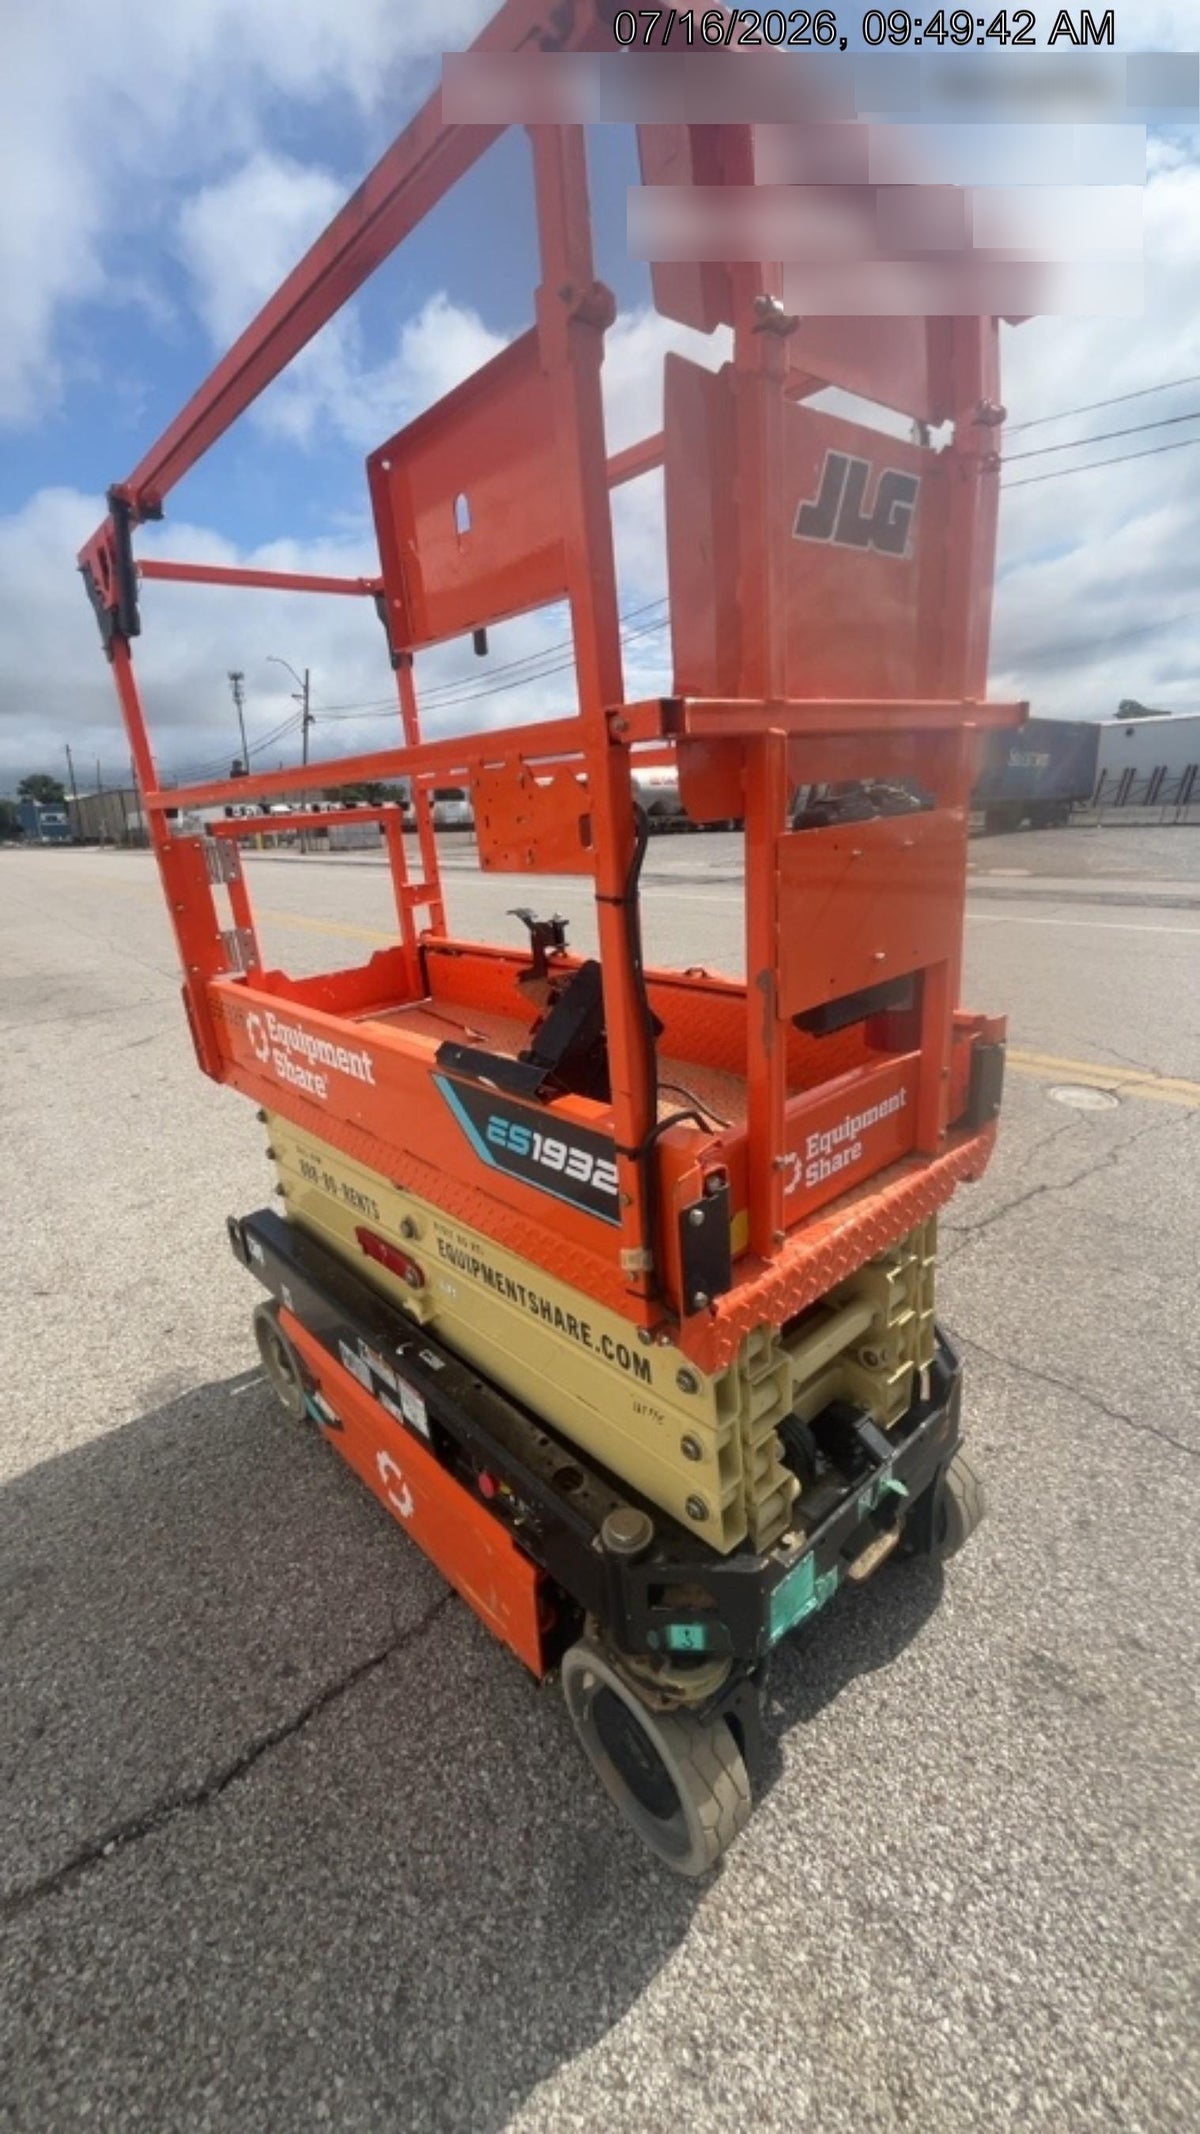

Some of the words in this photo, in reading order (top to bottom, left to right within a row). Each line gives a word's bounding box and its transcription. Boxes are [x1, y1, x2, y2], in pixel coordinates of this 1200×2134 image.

[792, 448, 921, 559] JLG
[265, 1011, 376, 1086] Equipment
[272, 1047, 328, 1099] Share
[486, 1115, 620, 1196] ES1932
[805, 1086, 907, 1160] Equipment
[805, 1142, 863, 1188] Share
[437, 1237, 653, 1385] EQUIPMENTSHARE.COM
